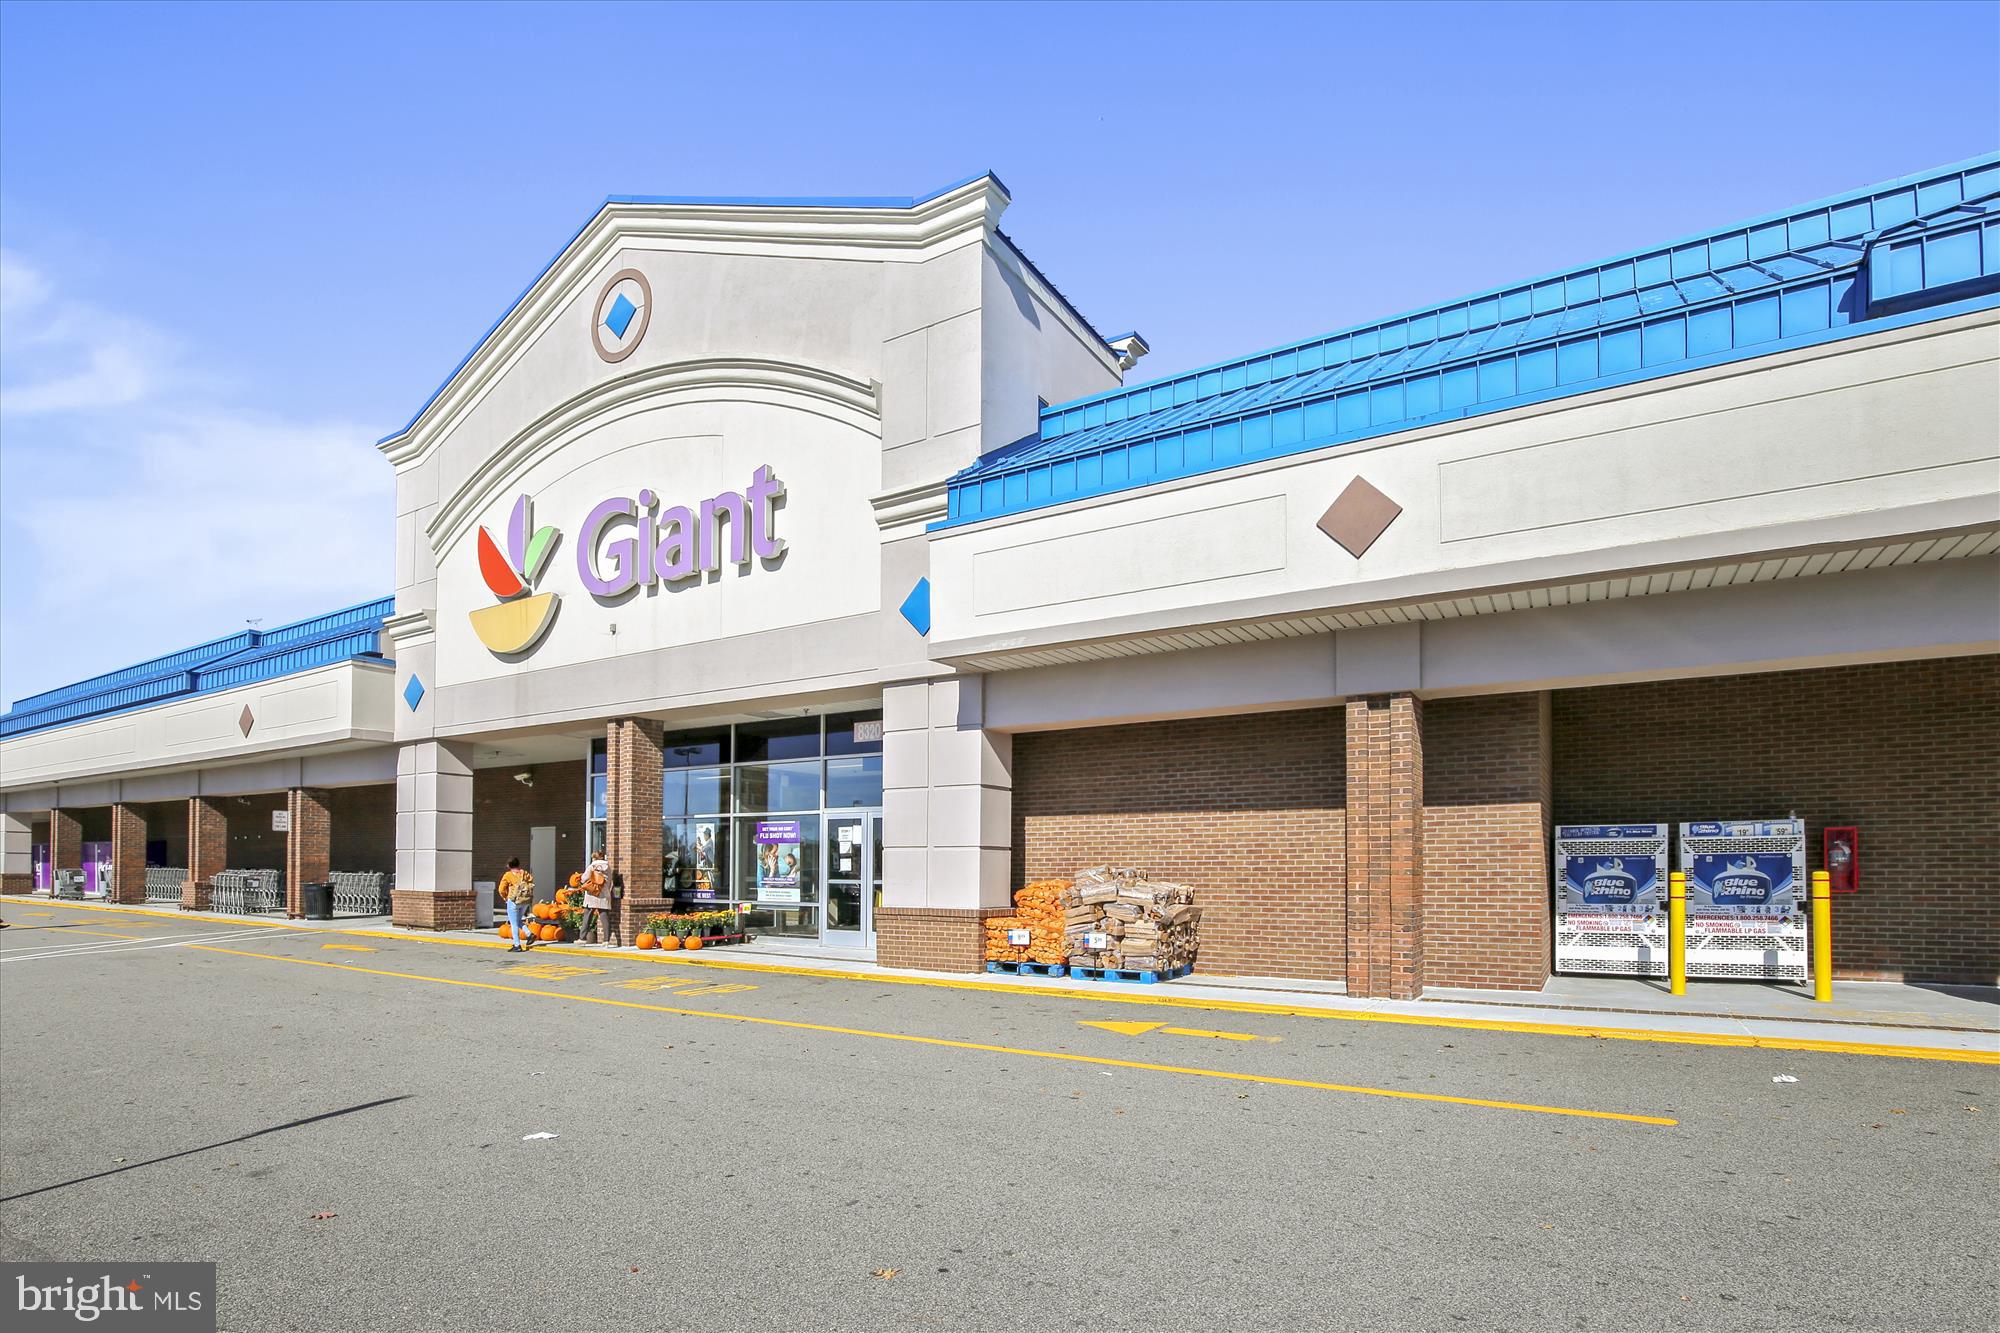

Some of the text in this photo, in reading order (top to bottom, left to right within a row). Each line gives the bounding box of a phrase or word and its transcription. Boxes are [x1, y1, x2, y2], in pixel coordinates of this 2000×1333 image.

[577, 464, 786, 597] Giant
[858, 723, 881, 740] 8320
[1724, 878, 1758, 886] Blue
[1591, 886, 1631, 896] Rhino
[1721, 886, 1765, 896] Rhino
